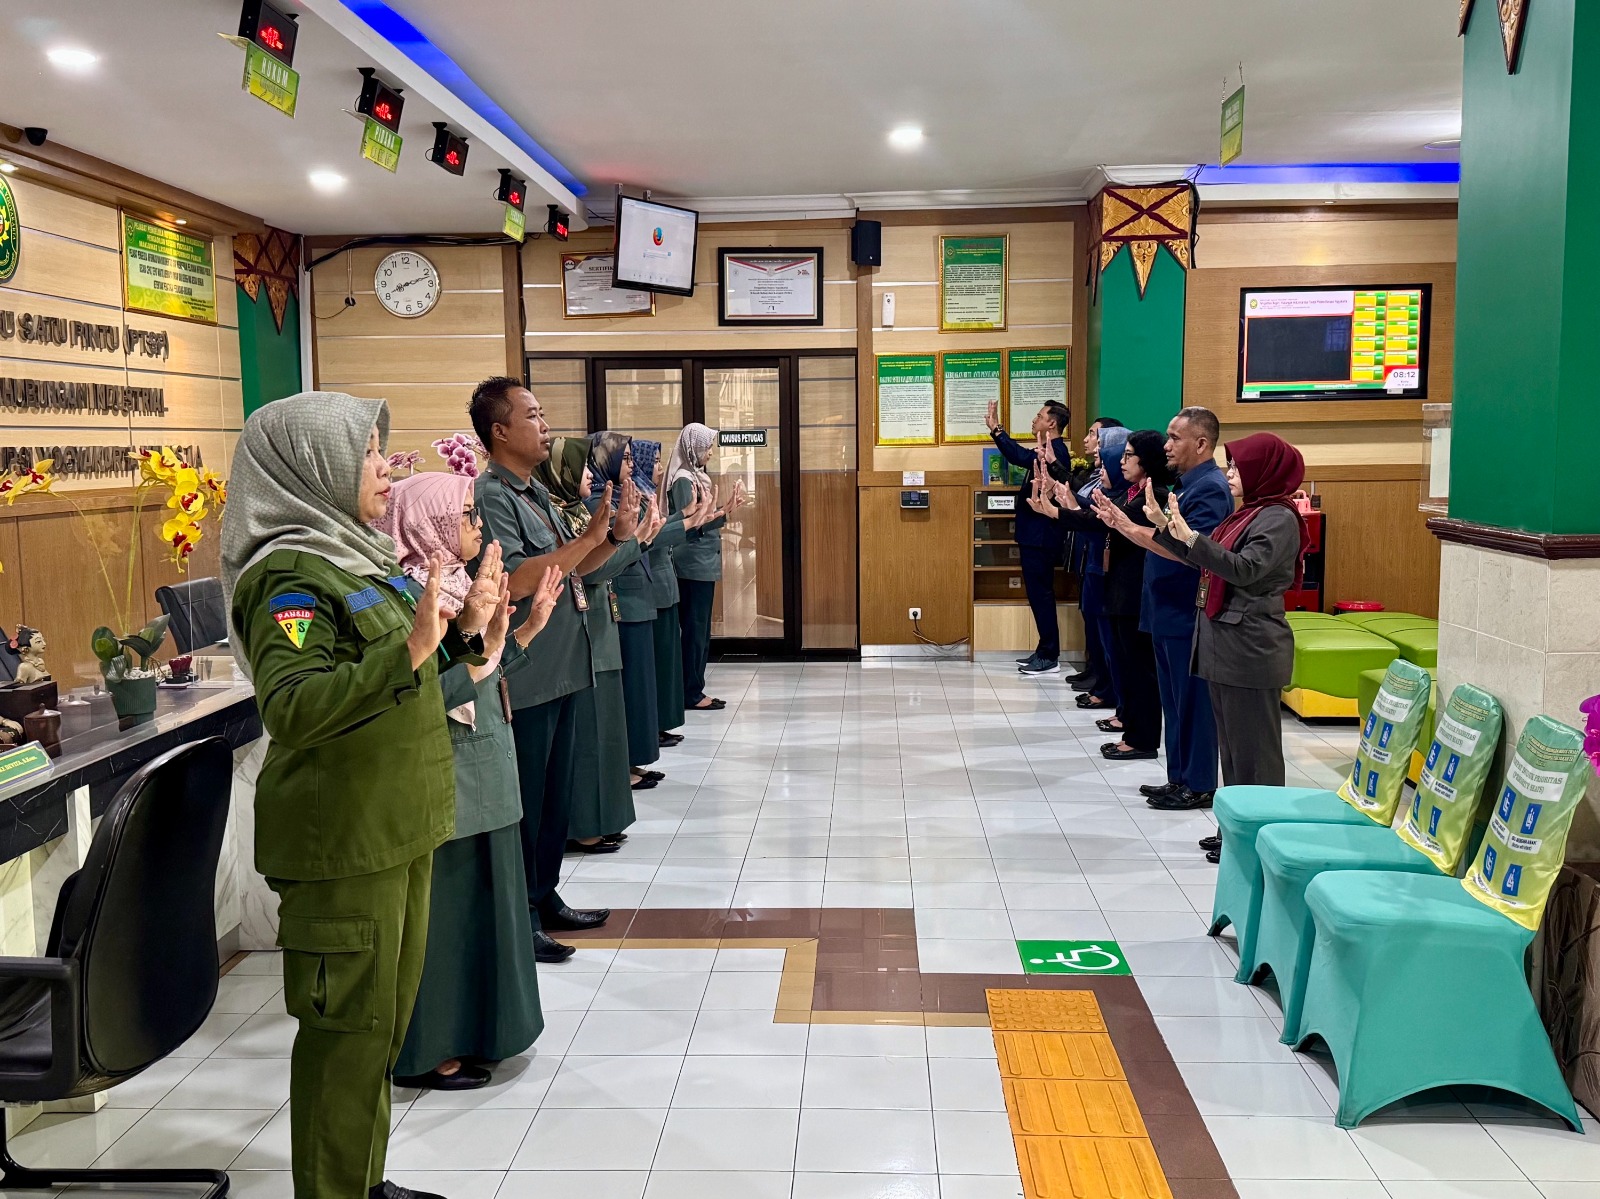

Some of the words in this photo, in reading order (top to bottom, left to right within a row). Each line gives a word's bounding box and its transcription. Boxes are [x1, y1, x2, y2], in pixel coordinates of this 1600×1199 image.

[18, 312, 67, 345] SATU
[69, 320, 119, 352] PINTU
[122, 324, 169, 361] (PTSP)
[87, 382, 169, 412] INDUSTRIAL
[721, 433, 741, 443] KHUSUS
[742, 433, 764, 443] PETUGAS
[285, 623, 293, 634] P
[298, 622, 306, 633] S
[1534, 775, 1563, 785] PRIORITAS
